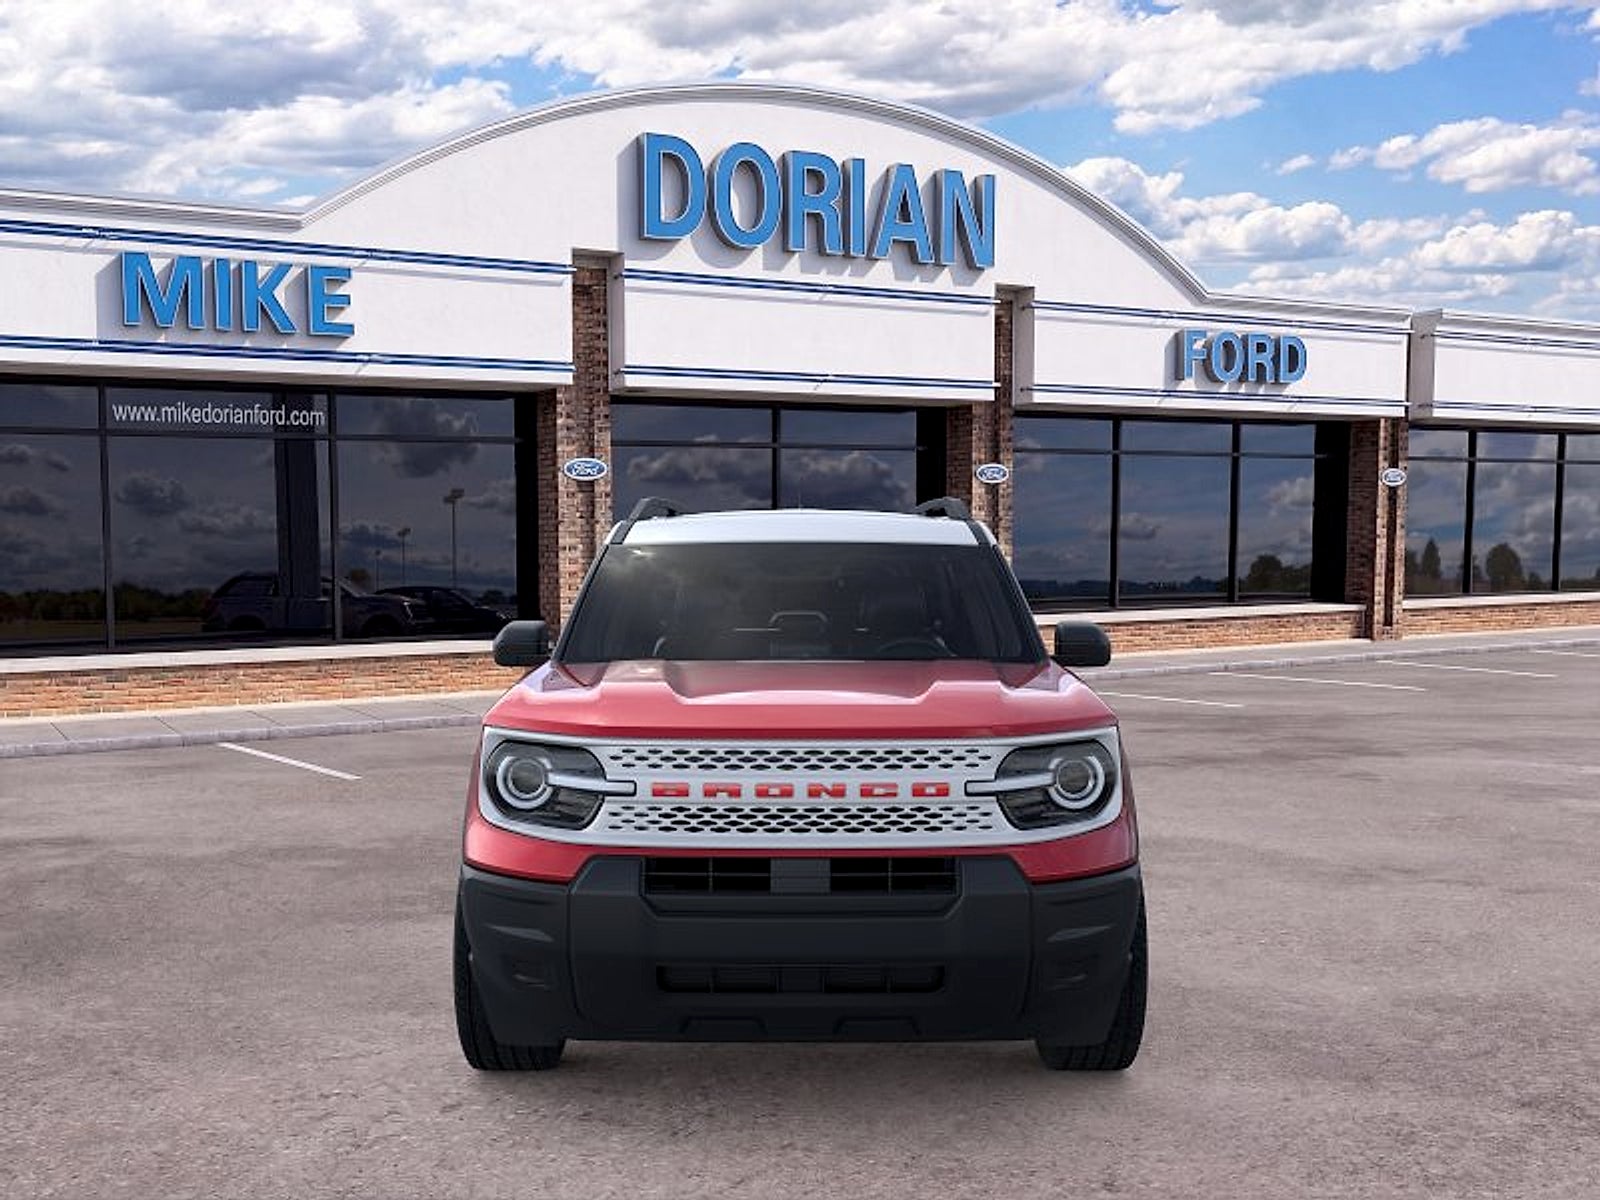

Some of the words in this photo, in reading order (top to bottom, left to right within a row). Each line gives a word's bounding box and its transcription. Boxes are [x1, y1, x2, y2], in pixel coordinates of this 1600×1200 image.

[641, 132, 996, 270] DORIAN
[120, 251, 355, 338] MIKE
[1182, 327, 1308, 384] FORD
[112, 402, 326, 426] www.mikedorianford.com
[571, 461, 600, 476] Ford
[651, 782, 950, 798] BRONCO
